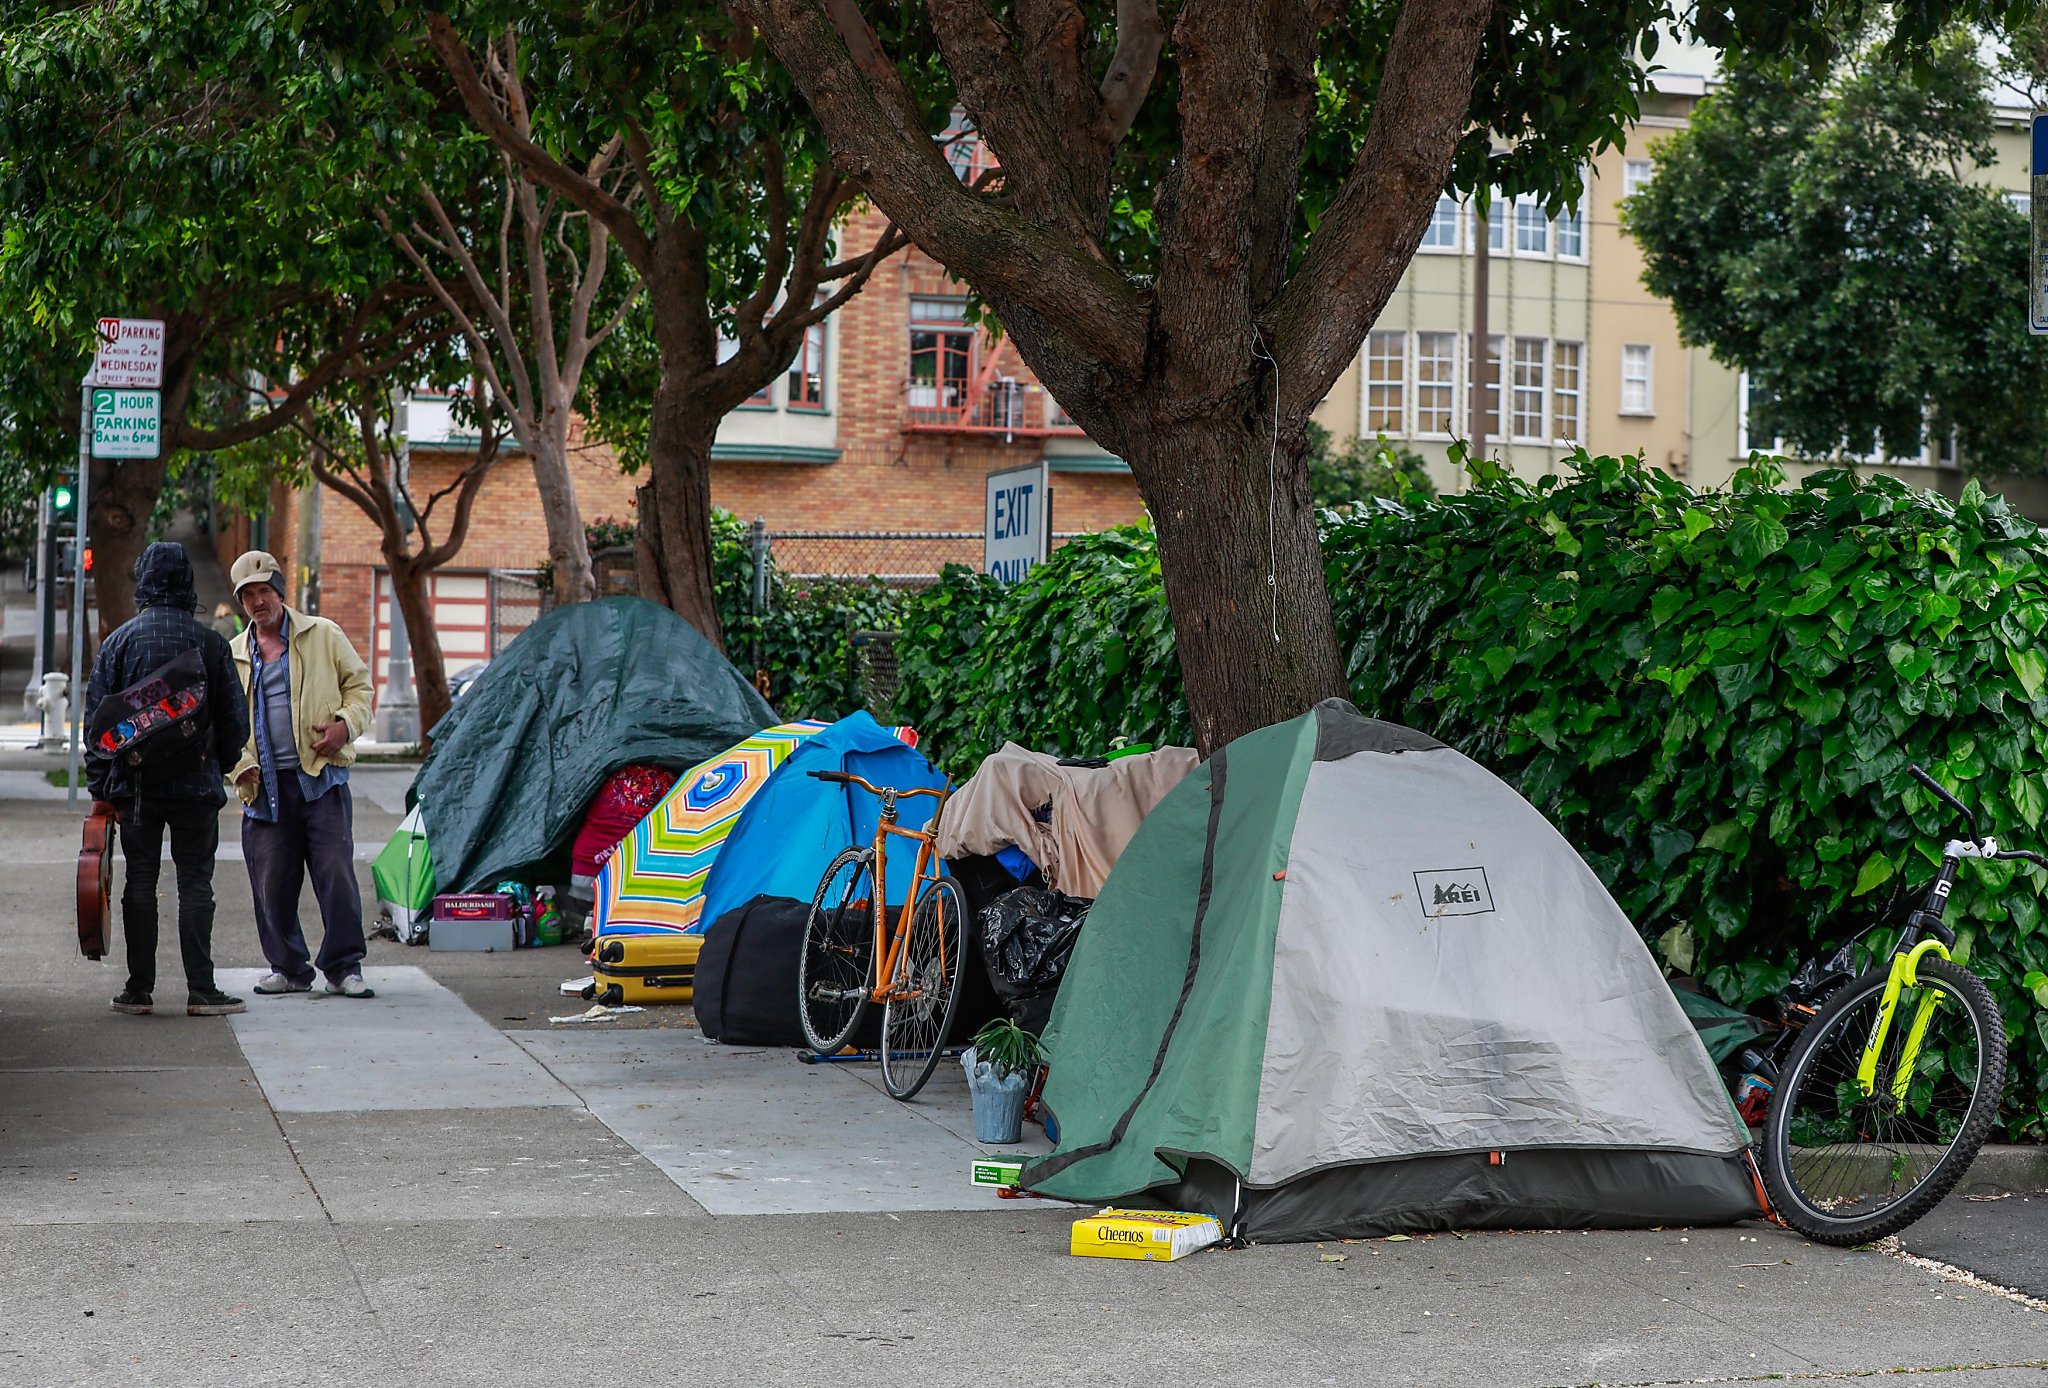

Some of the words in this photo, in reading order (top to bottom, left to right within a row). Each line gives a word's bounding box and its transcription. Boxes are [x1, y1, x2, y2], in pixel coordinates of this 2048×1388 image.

[100, 321, 119, 339] NO
[121, 326, 160, 340] PARKING
[100, 360, 158, 372] WEDNESDAY
[96, 393, 112, 412] 2
[120, 396, 154, 409] HOUR
[96, 417, 157, 430] PARKING
[995, 484, 1033, 540] EXIT
[1447, 889, 1481, 904] REI
[445, 901, 495, 909] BALDERDASH
[1098, 1225, 1144, 1243] Cheerios
